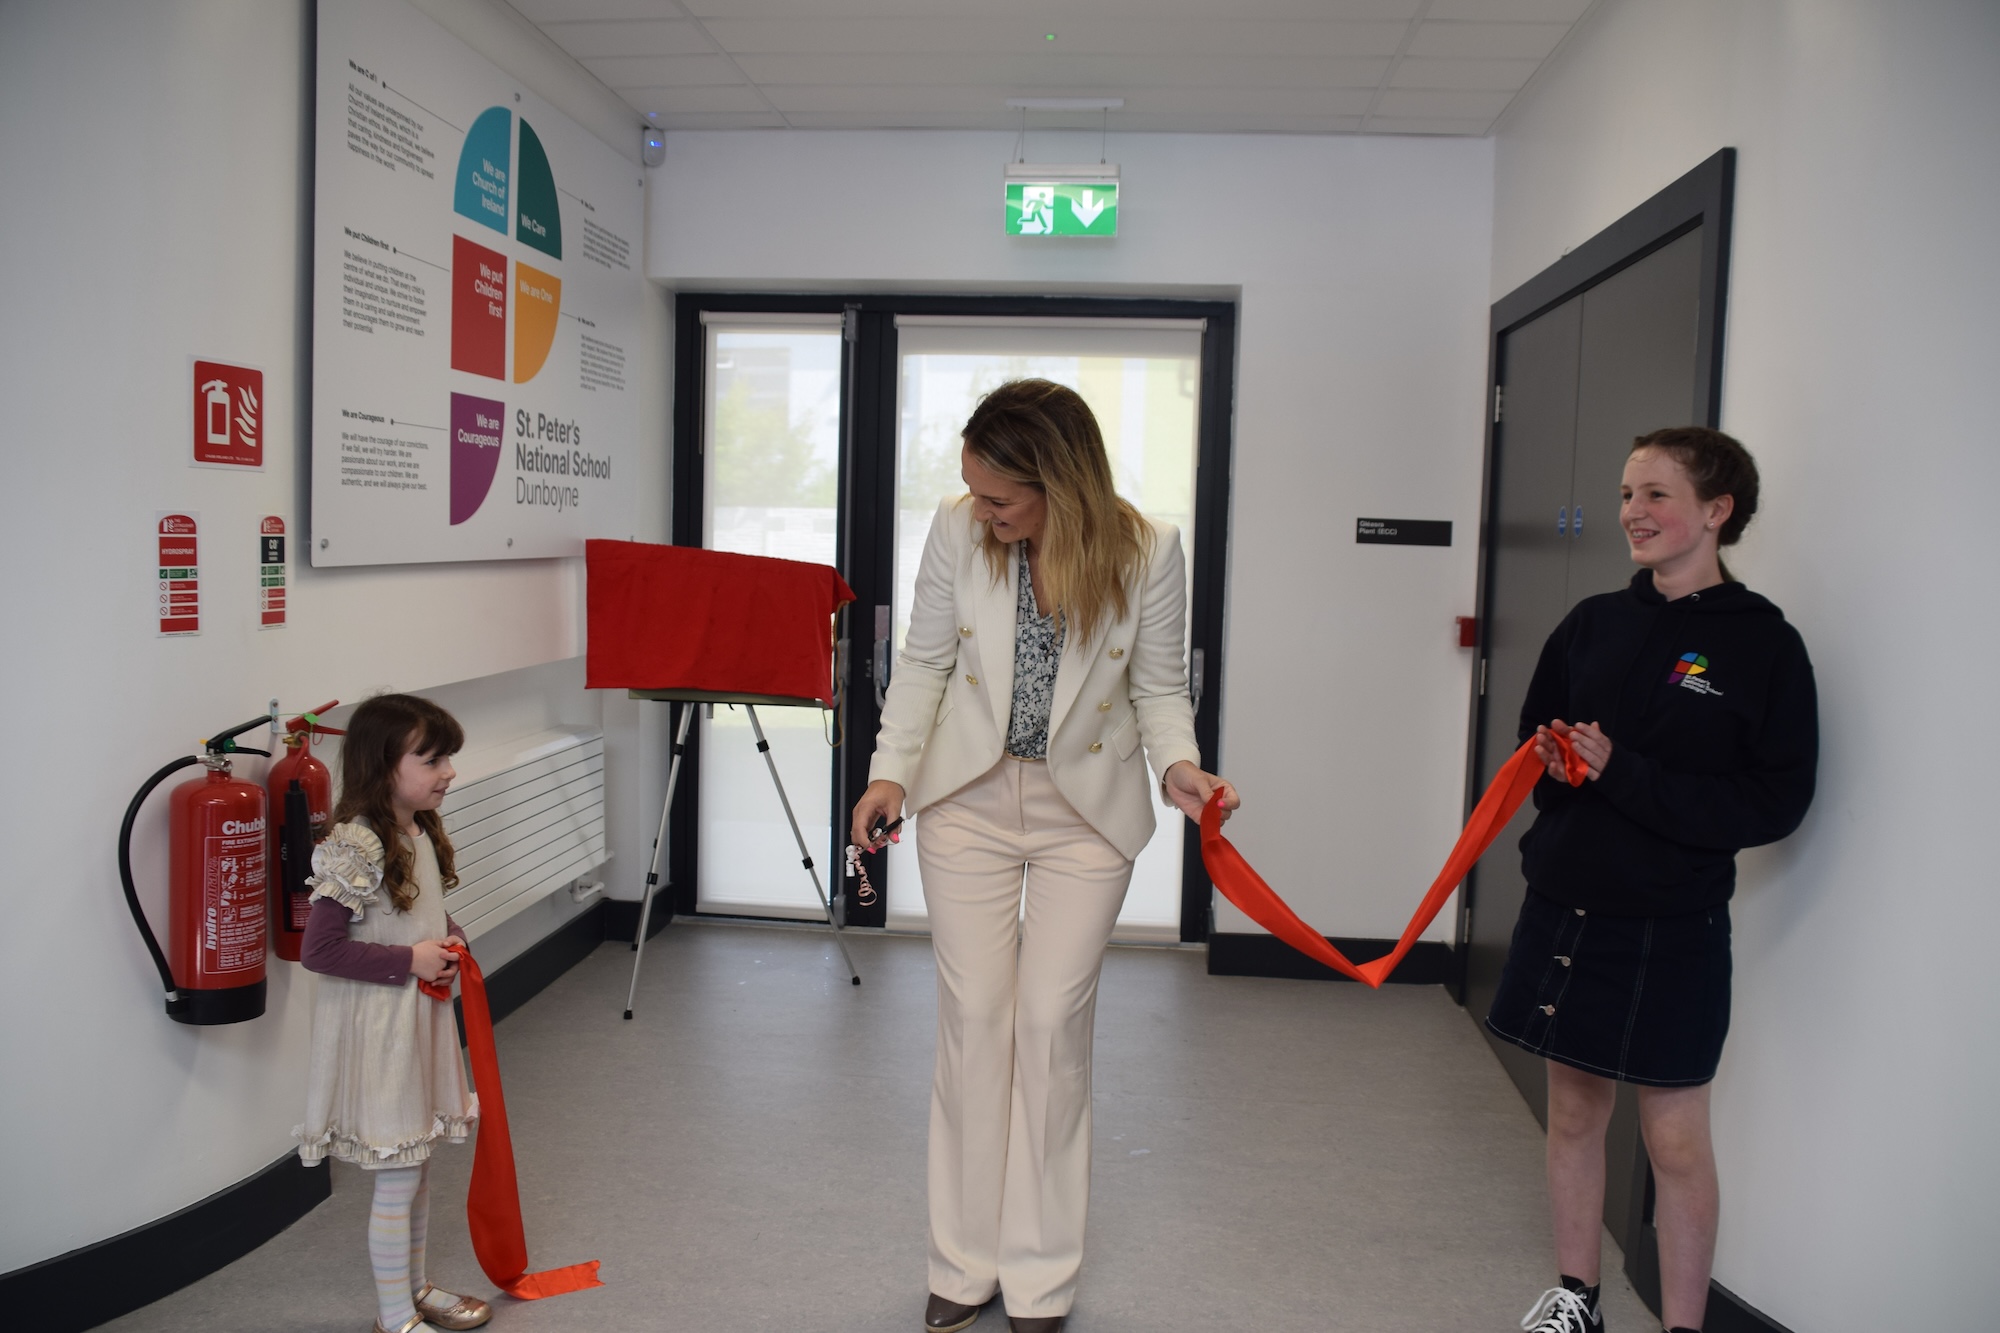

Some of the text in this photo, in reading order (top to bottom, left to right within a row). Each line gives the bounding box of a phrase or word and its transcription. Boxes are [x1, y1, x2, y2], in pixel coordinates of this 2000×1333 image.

[348, 94, 364, 109] Church
[483, 158, 506, 183] We are
[472, 171, 505, 200] Church of
[482, 194, 505, 217] Ireland
[521, 213, 546, 237] We Care
[344, 226, 352, 236] We
[352, 231, 360, 239] put
[361, 233, 380, 247] Children
[344, 250, 351, 259] We
[352, 253, 367, 265] believe
[388, 266, 404, 278] children
[480, 262, 504, 284] We put
[390, 276, 399, 287] That
[474, 278, 503, 301] Children
[519, 279, 553, 303] We are One
[488, 302, 503, 319] first
[342, 409, 349, 417] We
[358, 411, 385, 423] Courageous
[476, 413, 499, 430] We are
[516, 408, 580, 446] St. Peter's
[342, 432, 349, 440] We
[358, 434, 368, 442] have
[377, 437, 393, 447] courage
[458, 429, 499, 448] Courageous
[341, 455, 365, 465] passionate
[516, 442, 611, 480] National School
[341, 467, 374, 476] compassionate
[516, 476, 579, 513] Dunboyne
[222, 816, 266, 835] Chubb
